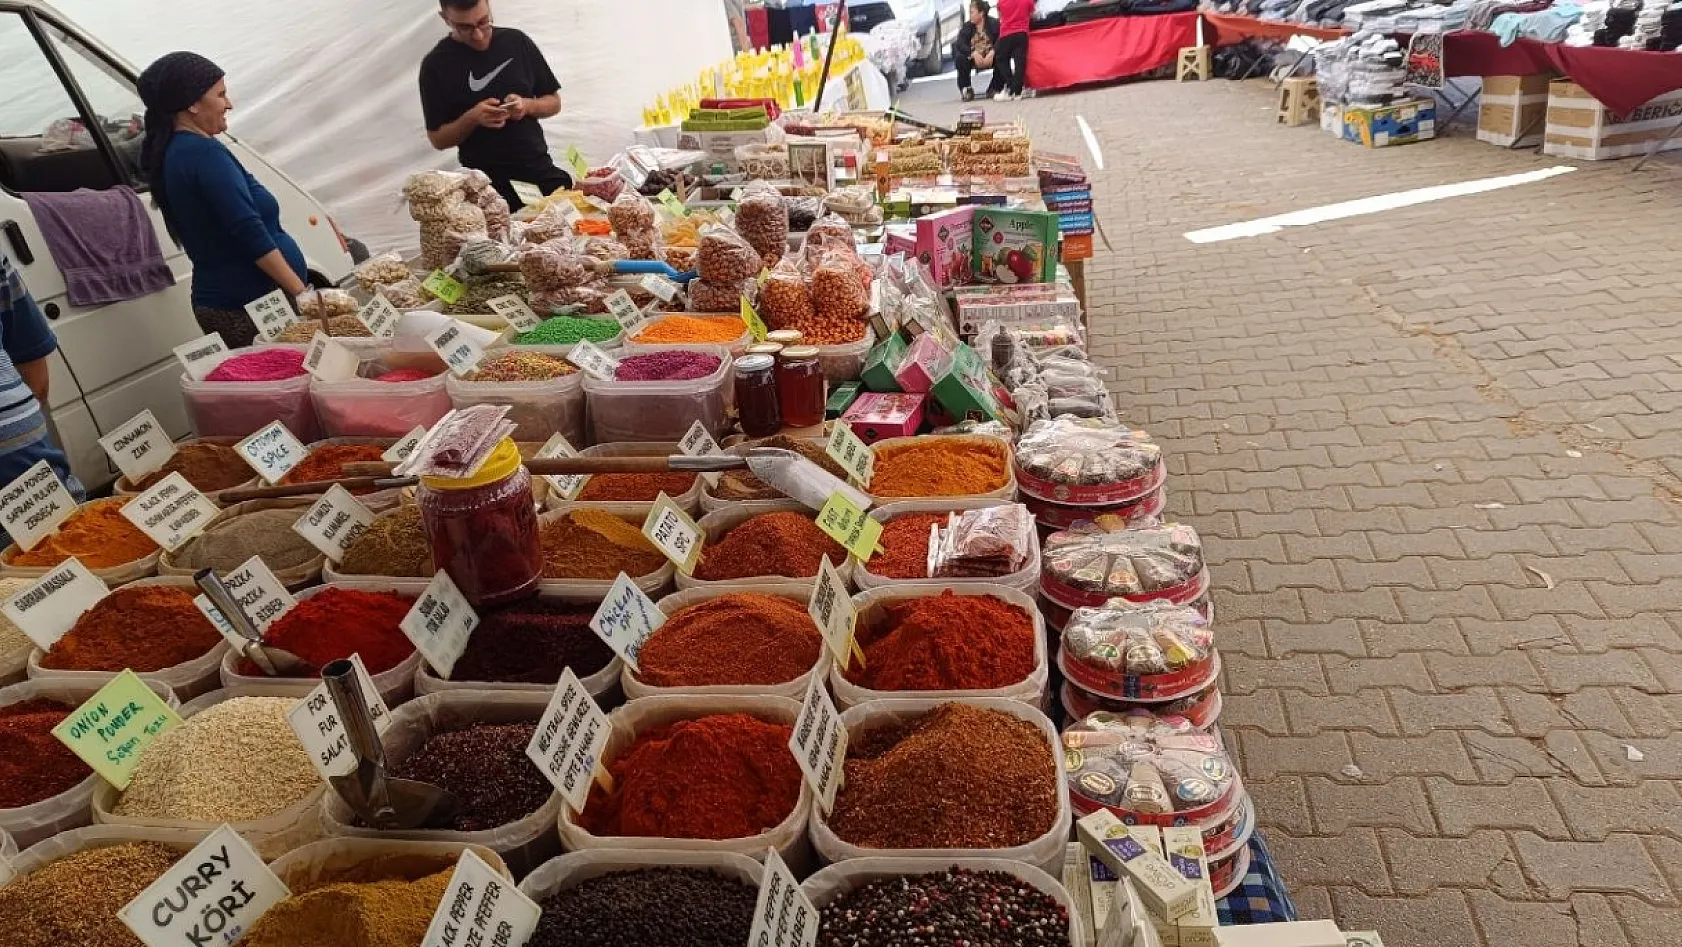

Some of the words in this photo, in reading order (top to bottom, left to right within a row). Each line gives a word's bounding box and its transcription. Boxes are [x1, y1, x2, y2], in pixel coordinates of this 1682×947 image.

[113, 420, 152, 453] CINNAMON
[133, 440, 152, 460] ZIMT
[261, 444, 289, 468] SPICE
[655, 511, 679, 545] PATATO
[222, 569, 255, 590] PRIKA
[599, 586, 634, 637] Chicken
[307, 693, 327, 716] FOR
[539, 709, 565, 755] MEATBALL
[561, 684, 577, 712] SPICE
[321, 733, 349, 766] SALAT
[152, 845, 231, 927] CURRY
[449, 881, 474, 925] PEPPER
[764, 871, 782, 929] PEPPER
[185, 880, 257, 947] KÖRİ
[474, 881, 501, 931] PFEFFER
